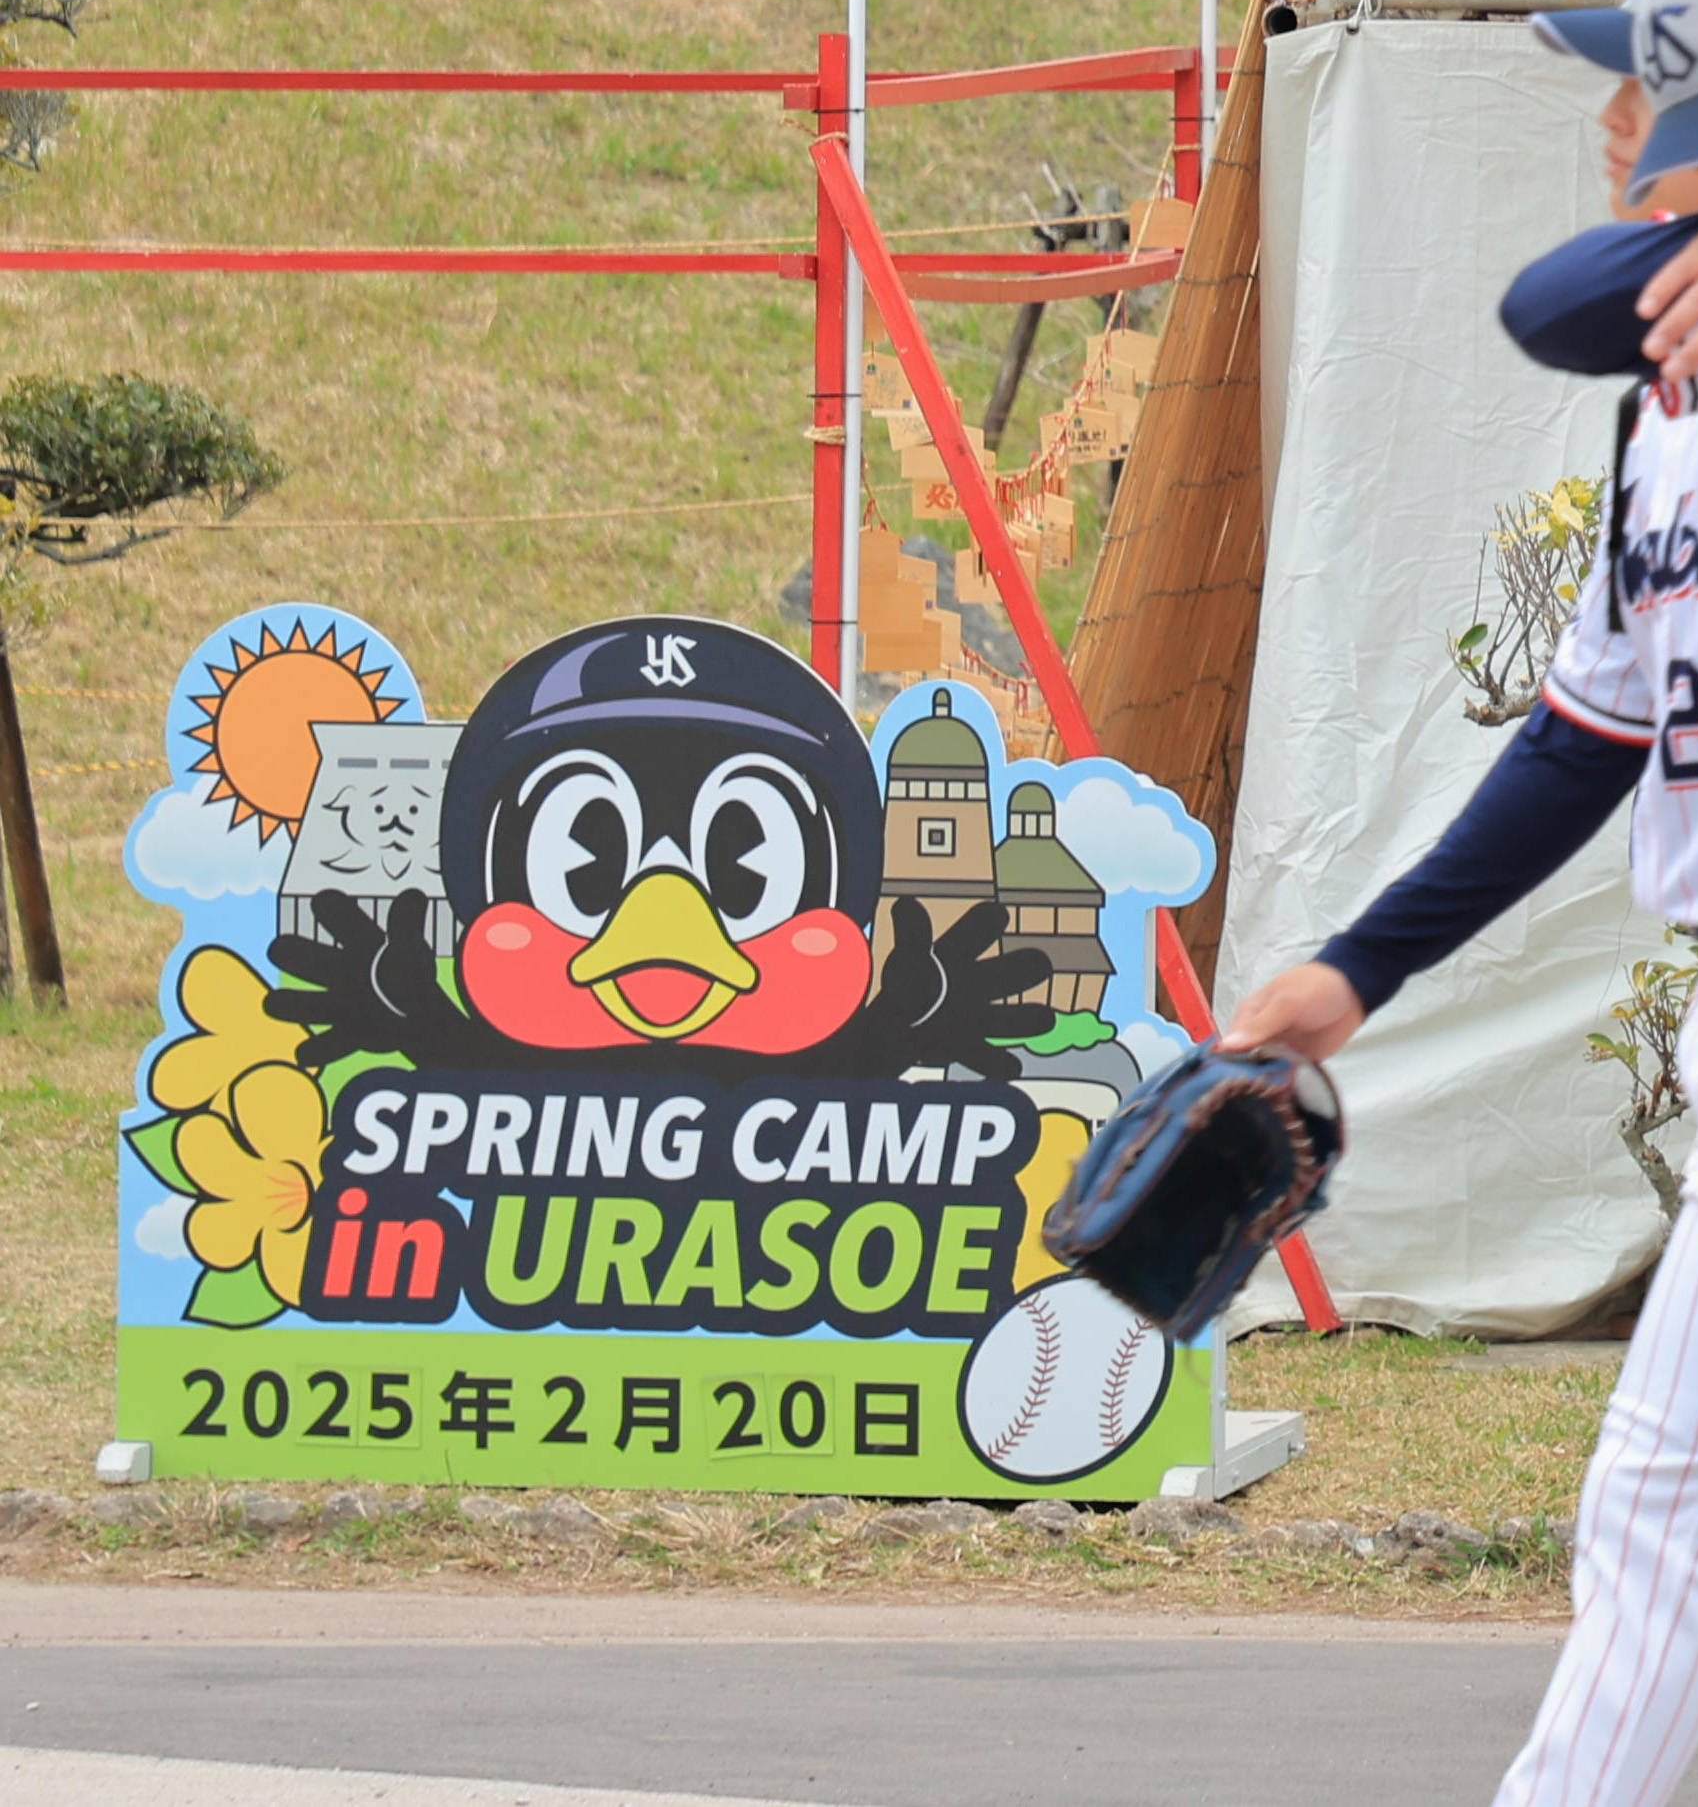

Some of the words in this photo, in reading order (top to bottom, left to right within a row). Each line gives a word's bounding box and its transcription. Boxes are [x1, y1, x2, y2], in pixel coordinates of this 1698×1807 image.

[342, 1089, 706, 1187] SPRING
[730, 1101, 1017, 1187] CAMP
[321, 1188, 447, 1302] in
[484, 1194, 1003, 1314] URASOE
[180, 1368, 922, 1458] 2025年2月20日
